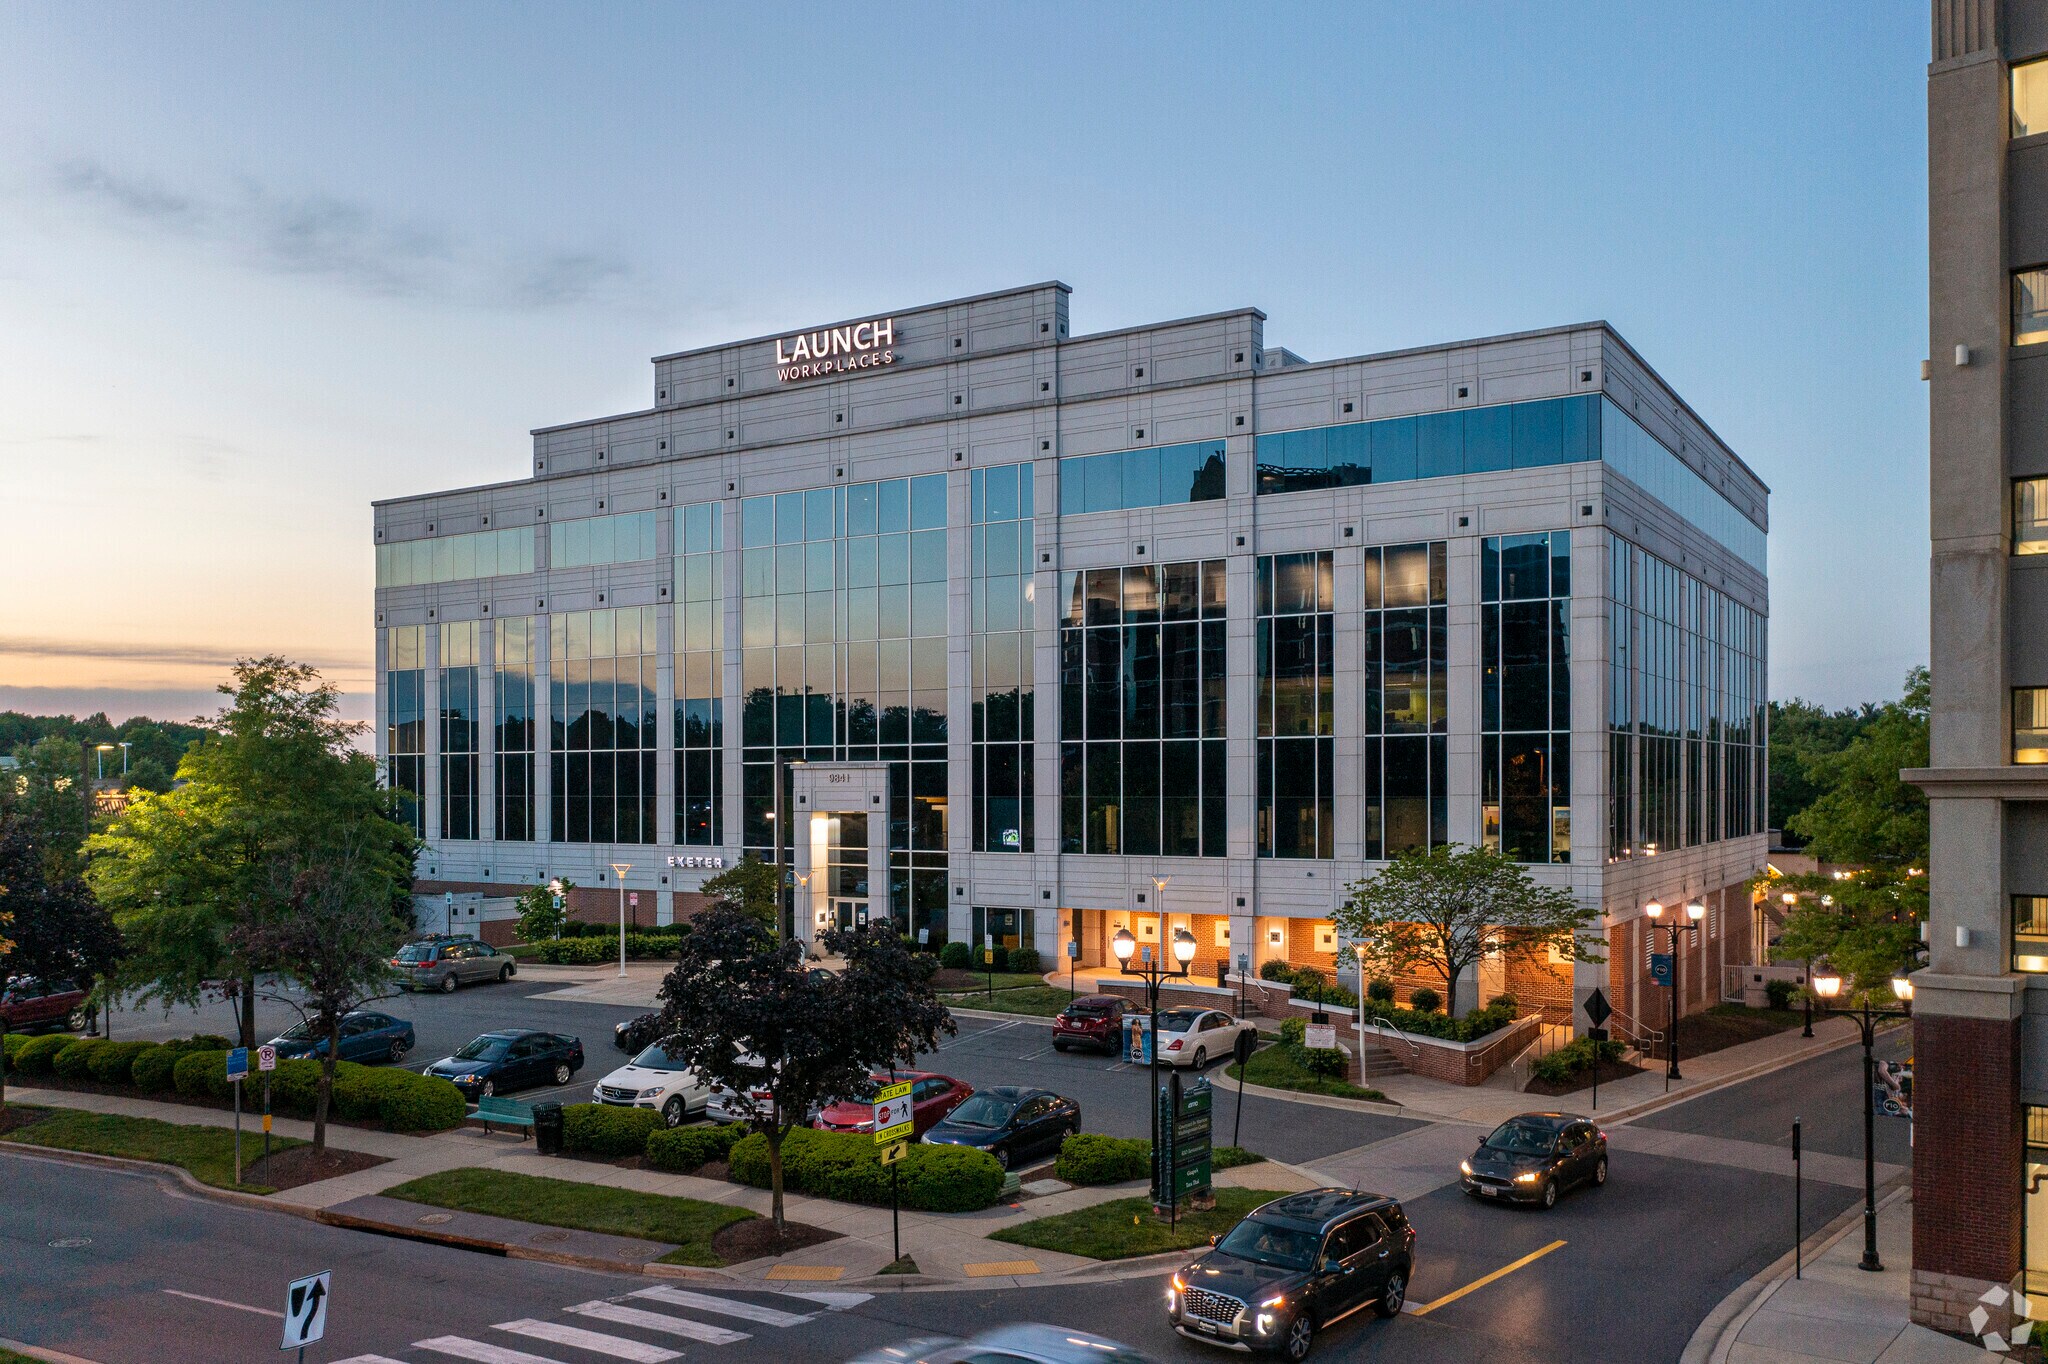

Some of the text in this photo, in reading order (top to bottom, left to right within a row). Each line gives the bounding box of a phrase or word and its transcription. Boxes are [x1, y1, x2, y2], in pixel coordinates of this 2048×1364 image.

[776, 318, 893, 364] LAUNCH
[777, 350, 893, 381] WORKPLACES
[829, 773, 850, 783] 9841
[667, 856, 722, 868] EXETER
[876, 1085, 908, 1100] STATE LAW
[879, 1110, 890, 1119] STOP
[884, 1124, 910, 1138] CROSSWALKS
